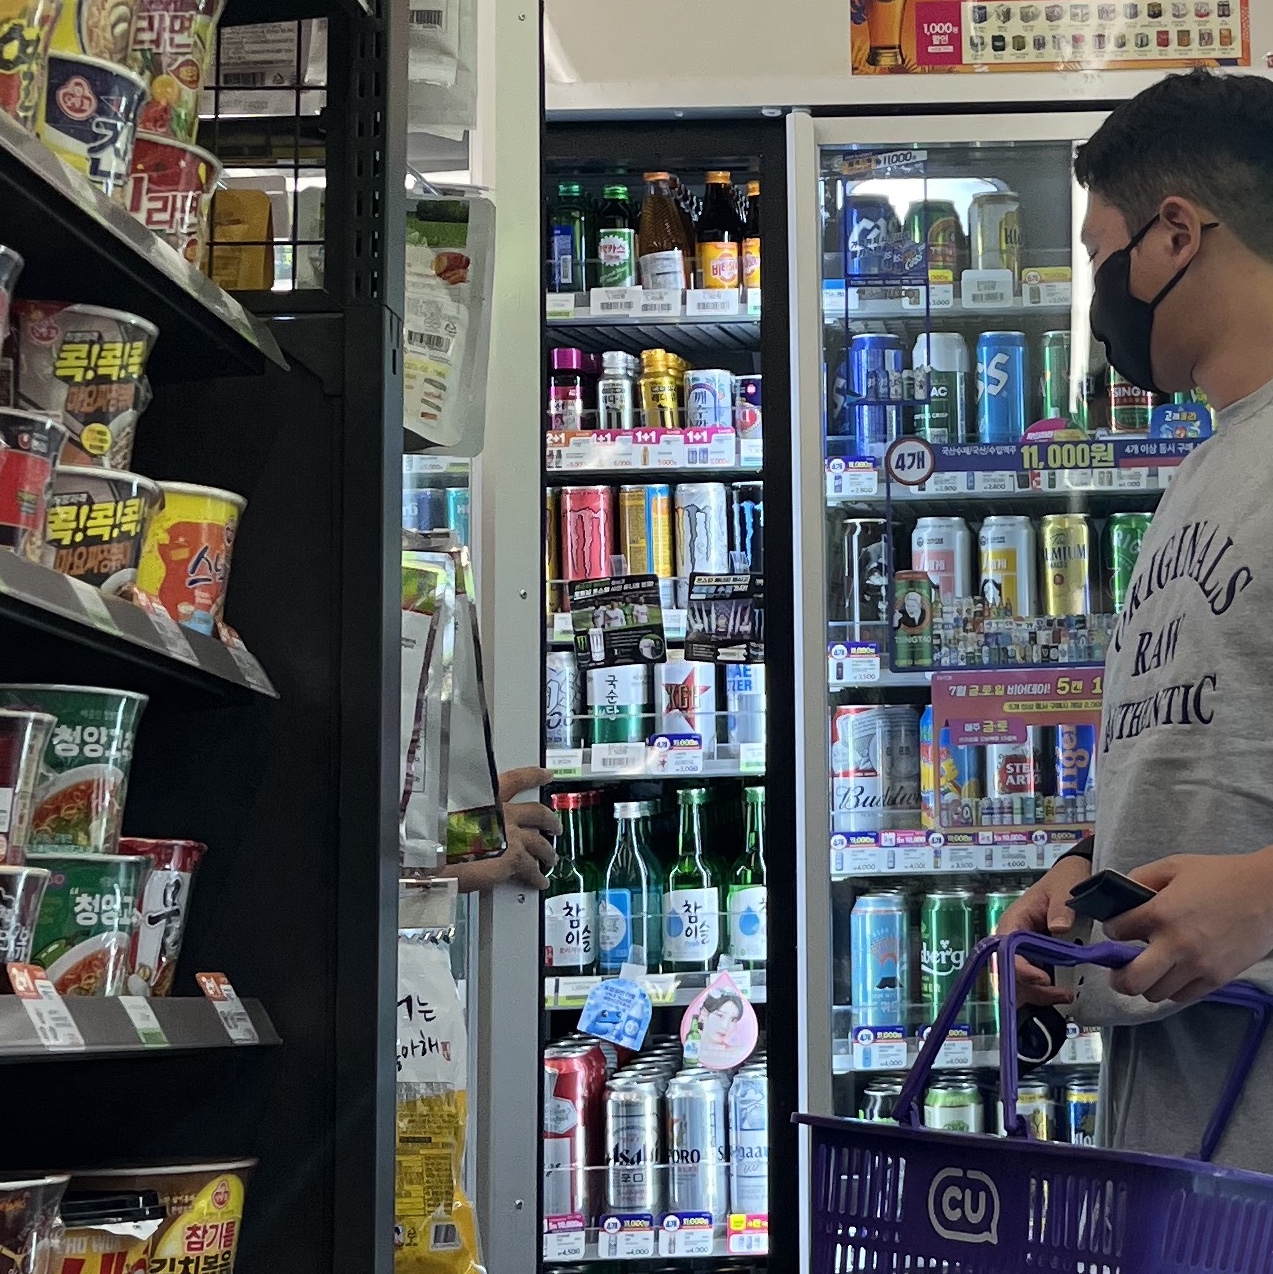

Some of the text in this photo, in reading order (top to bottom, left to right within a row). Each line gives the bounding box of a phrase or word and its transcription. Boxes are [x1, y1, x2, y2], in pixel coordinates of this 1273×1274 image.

[687, 431, 708, 443] 1+1
[894, 451, 926, 472] 4개
[1020, 442, 1114, 470] 11,000원
[1131, 613, 1187, 677] RAW
[941, 1185, 986, 1224] CU
[182, 1220, 236, 1252] 참기름
